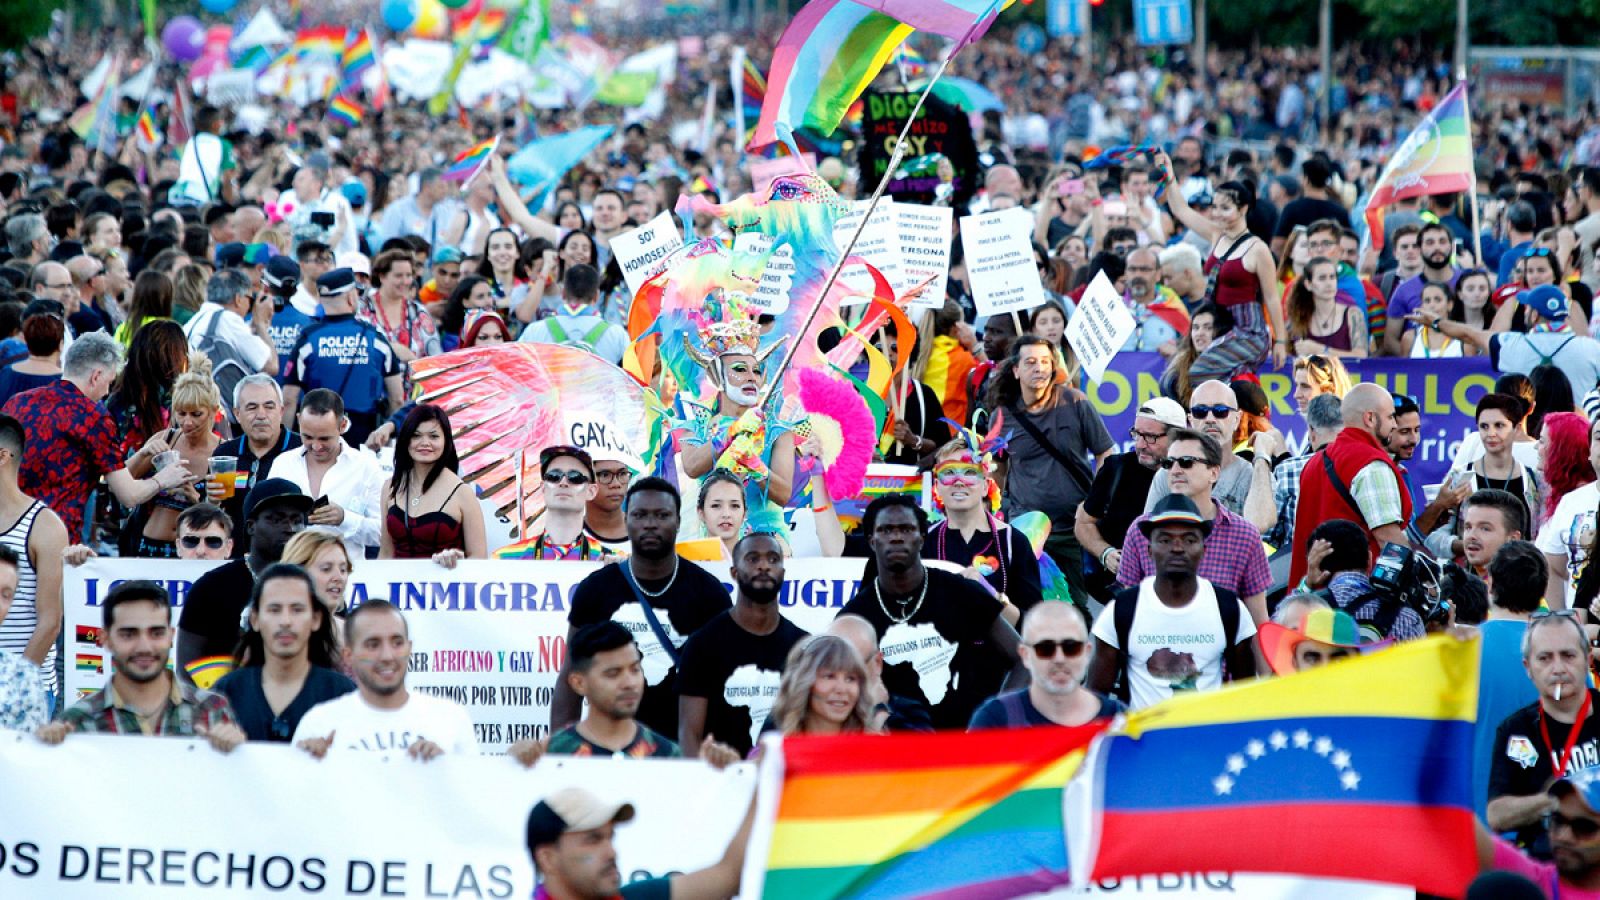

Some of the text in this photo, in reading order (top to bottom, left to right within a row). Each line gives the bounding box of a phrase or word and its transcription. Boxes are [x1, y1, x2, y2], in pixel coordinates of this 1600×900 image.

[869, 94, 926, 120] DIOS
[884, 135, 928, 156] GAY
[637, 228, 655, 245] SOY
[624, 238, 681, 273] HOMOSEXUAL
[901, 246, 945, 256] ERSONA
[318, 332, 368, 347] POLICÍA
[318, 346, 369, 357] MUNICIPAL
[338, 356, 369, 365] Madrid
[571, 422, 611, 452] GAY,
[1138, 634, 1215, 644] SOMOS REFUGIADOS
[432, 650, 493, 672] AFRICANO
[497, 651, 506, 672] Y
[509, 651, 533, 673] GAY
[471, 686, 496, 706] POR
[500, 686, 532, 706] VIVIR
[535, 686, 554, 706] CO
[58, 844, 327, 892] DERECHOS
[346, 860, 407, 897] DE
[425, 863, 514, 899] LAS
